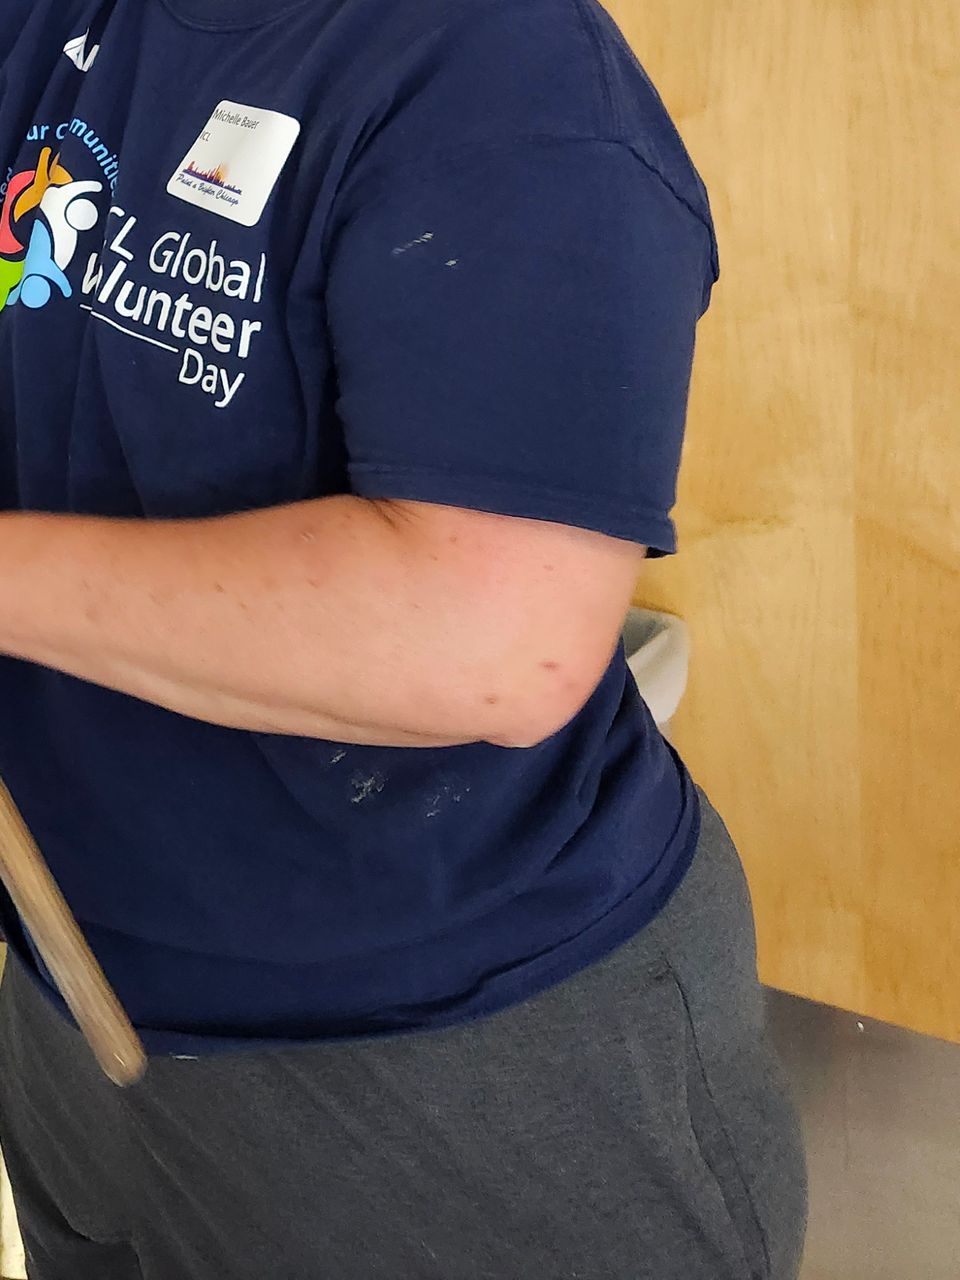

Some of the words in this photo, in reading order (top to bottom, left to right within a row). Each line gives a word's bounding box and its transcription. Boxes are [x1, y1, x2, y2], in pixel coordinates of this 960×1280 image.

[213, 109, 241, 125] Michelle
[148, 231, 266, 304] Global
[81, 252, 262, 359] Vlunteer
[178, 347, 245, 409] Day
